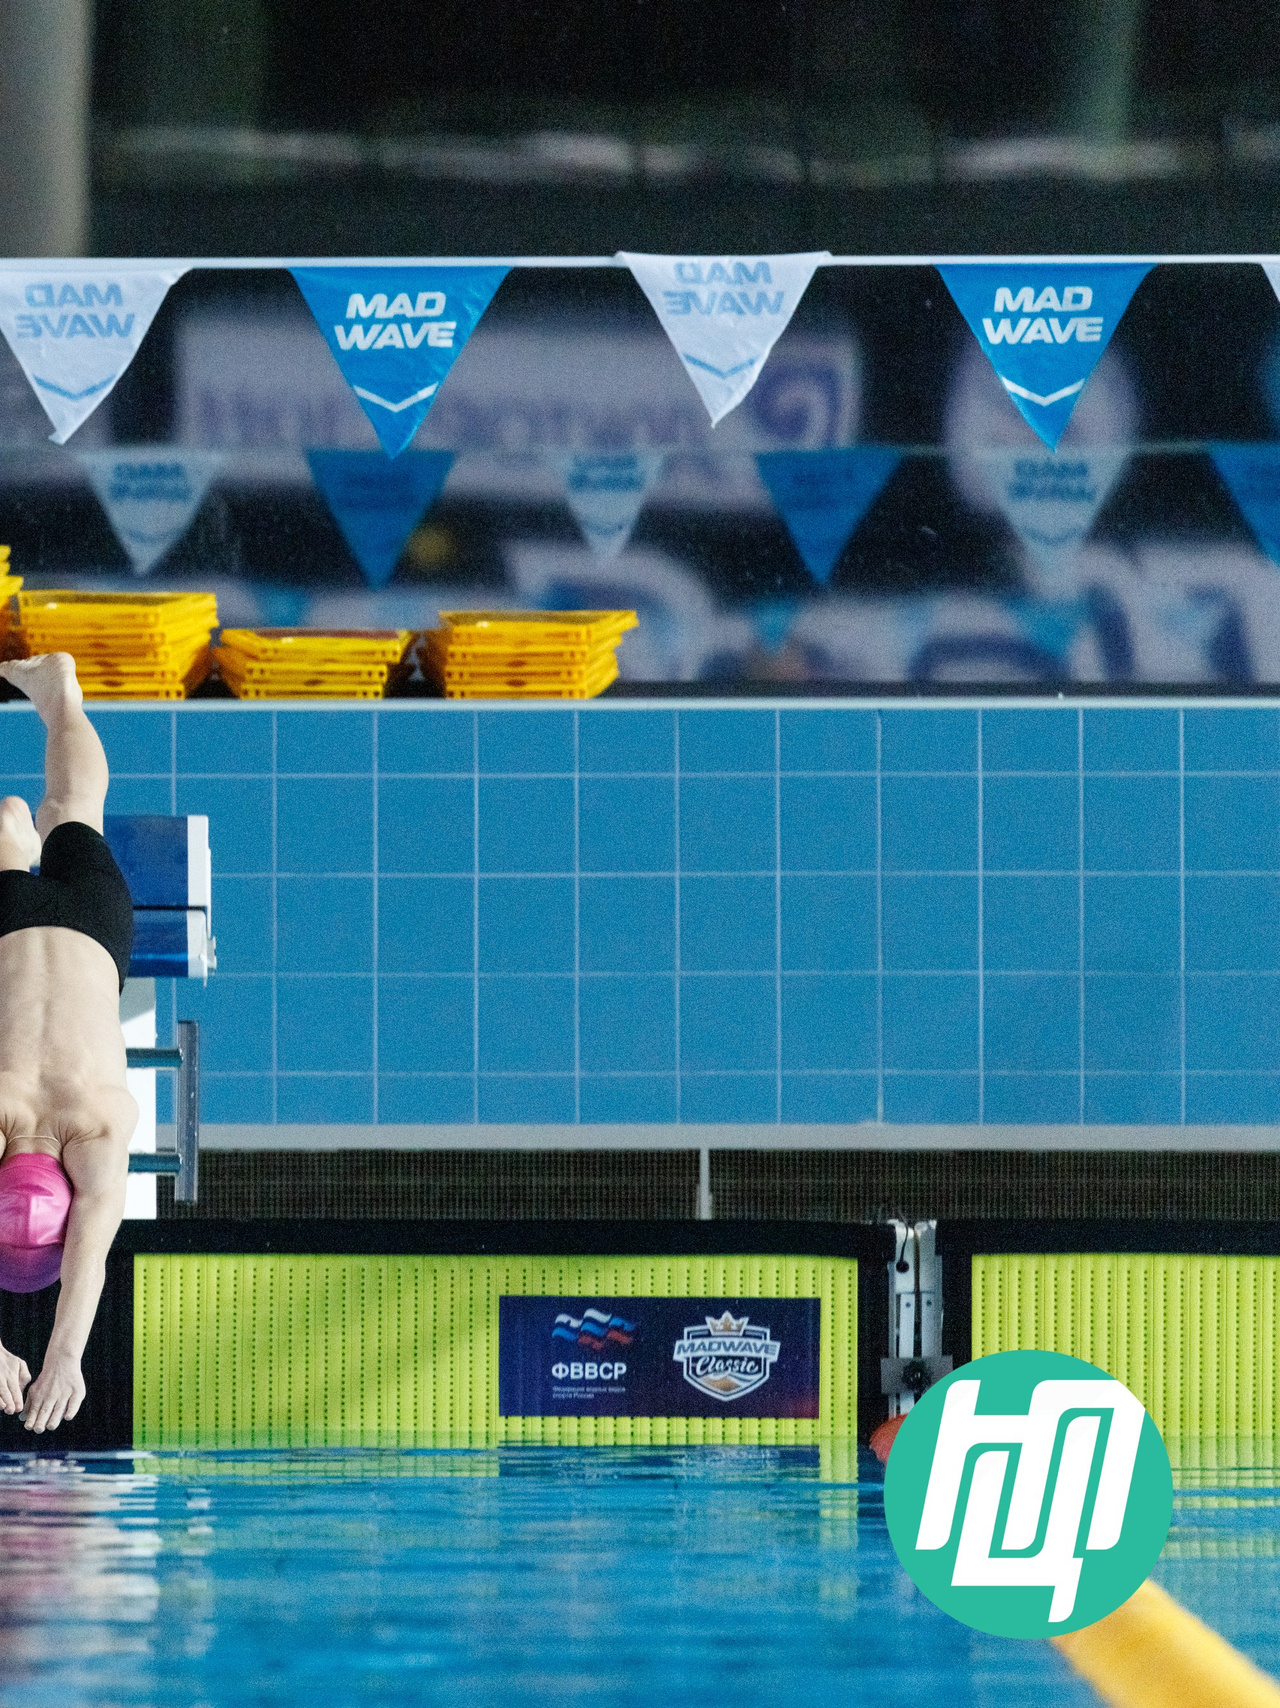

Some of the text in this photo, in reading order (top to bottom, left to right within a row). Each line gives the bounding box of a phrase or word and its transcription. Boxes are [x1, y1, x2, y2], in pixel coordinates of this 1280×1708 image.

[346, 291, 446, 318] MAD
[994, 286, 1093, 312] MAD
[334, 321, 457, 350] WAVE
[982, 317, 1104, 345] WAVE
[676, 1340, 778, 1356] MADWAVE
[551, 1361, 627, 1380] ФВВСР
[695, 1355, 759, 1376] Classic
